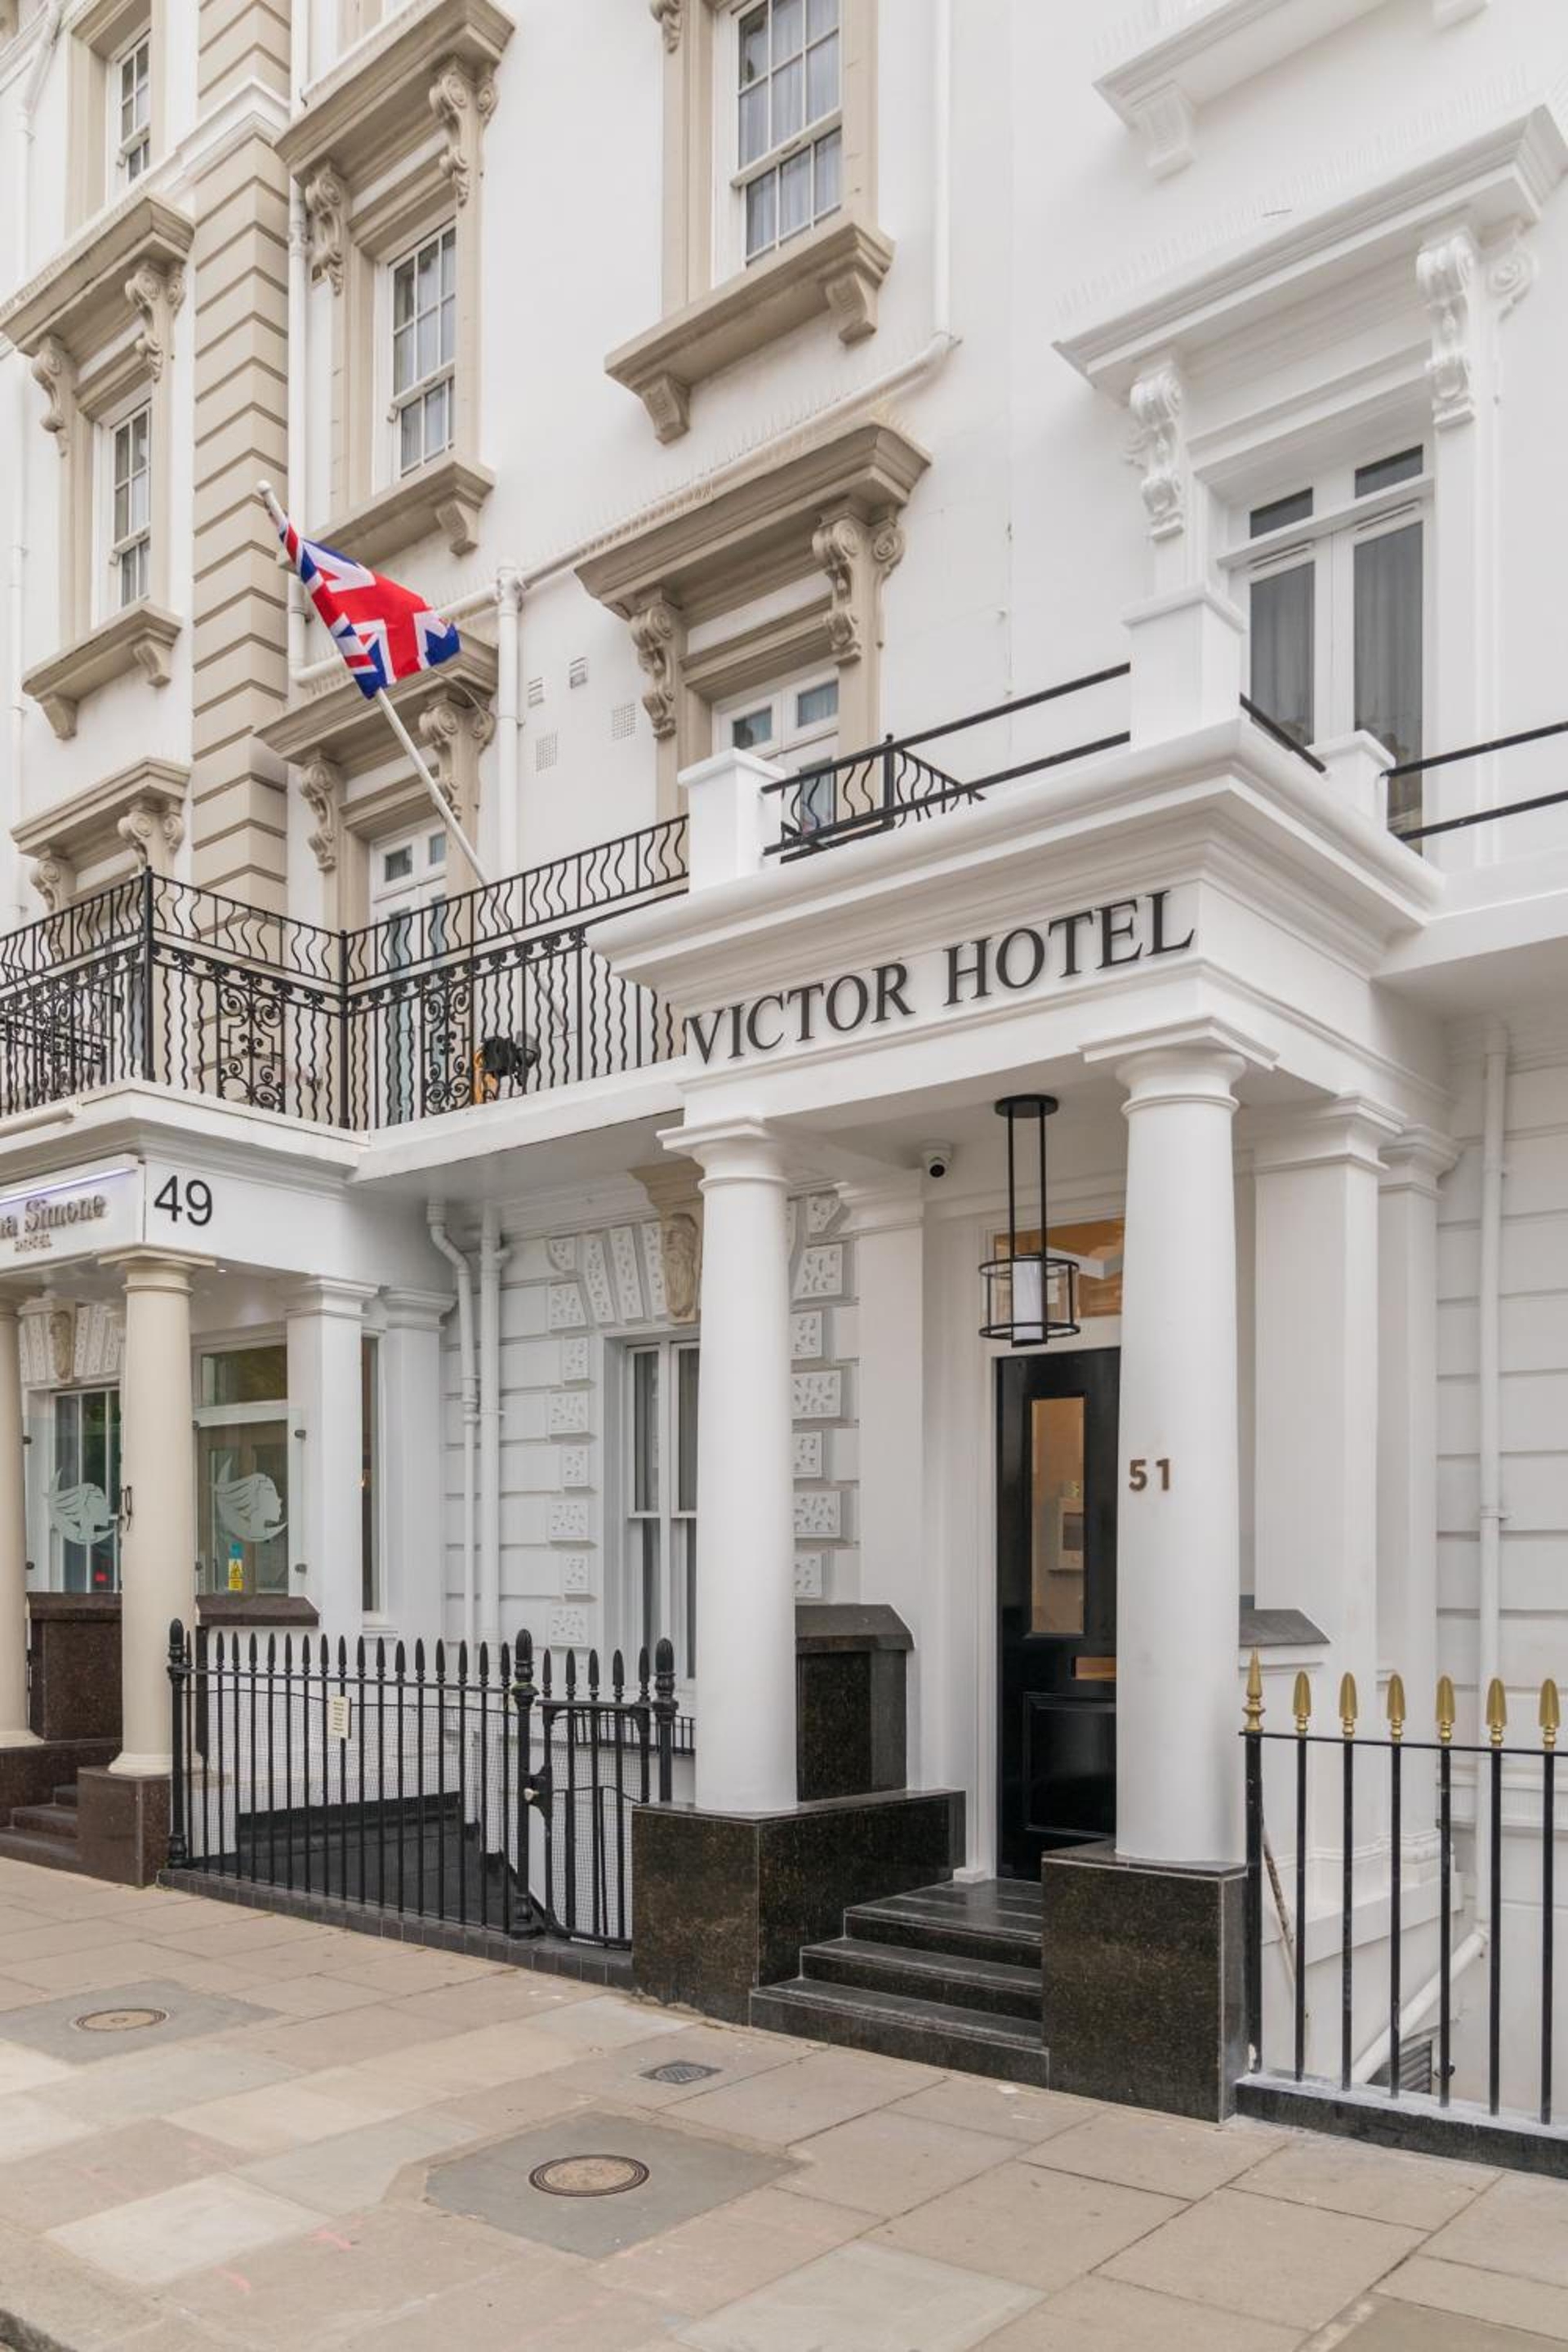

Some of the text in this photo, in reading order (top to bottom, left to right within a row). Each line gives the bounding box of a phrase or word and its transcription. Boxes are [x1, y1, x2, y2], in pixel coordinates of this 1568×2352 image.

[686, 890, 1195, 1065] VICTOR HOTEL
[24, 1194, 106, 1232] Simone
[154, 1175, 213, 1227] 49
[1129, 1459, 1169, 1492] 51
